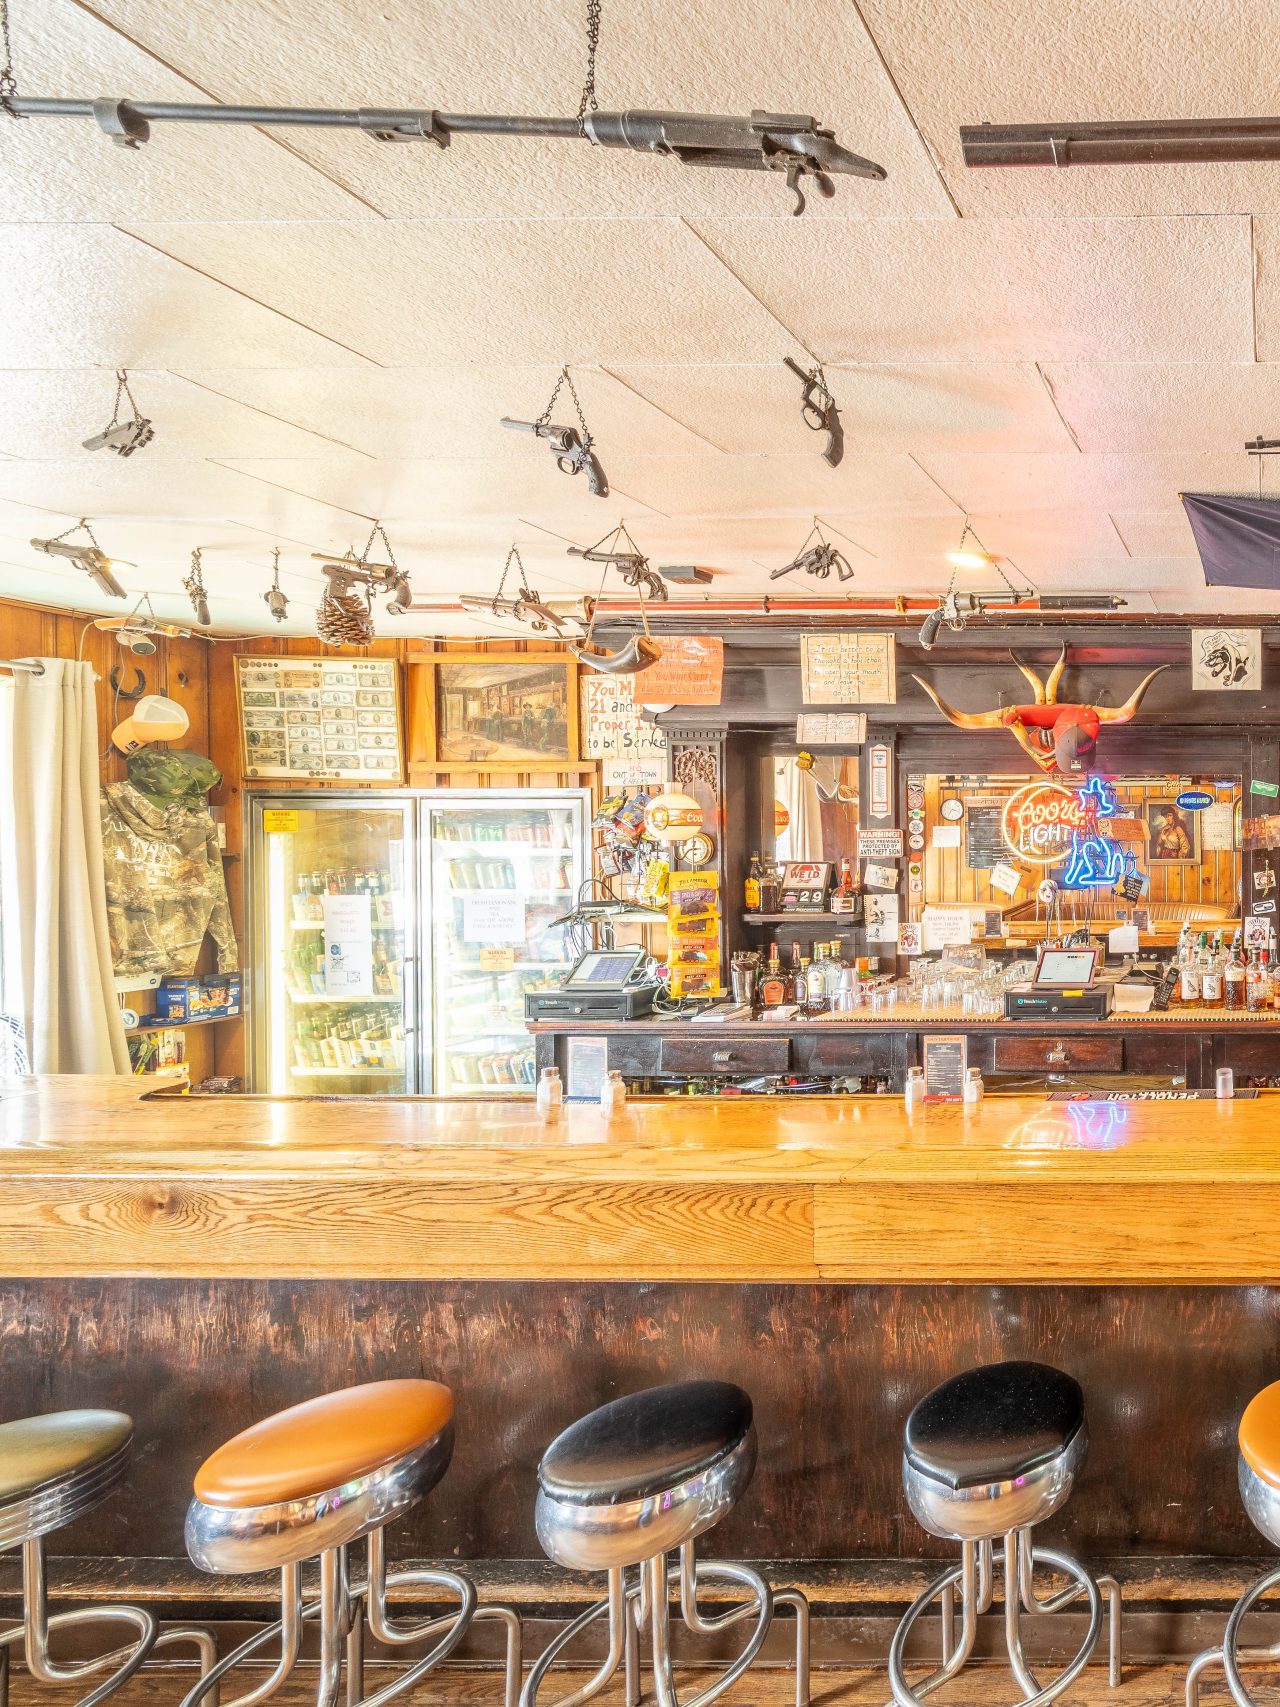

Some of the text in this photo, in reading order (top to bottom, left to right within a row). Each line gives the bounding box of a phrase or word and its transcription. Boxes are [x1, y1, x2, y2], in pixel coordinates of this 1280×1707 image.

[590, 681, 615, 697] You
[590, 699, 607, 714] 21
[590, 716, 631, 733] Proper
[588, 732, 667, 749] to be Served
[859, 831, 900, 839] WARNING!
[1019, 823, 1072, 852] LIGHT
[1107, 1091, 1200, 1101] PENDLETON
